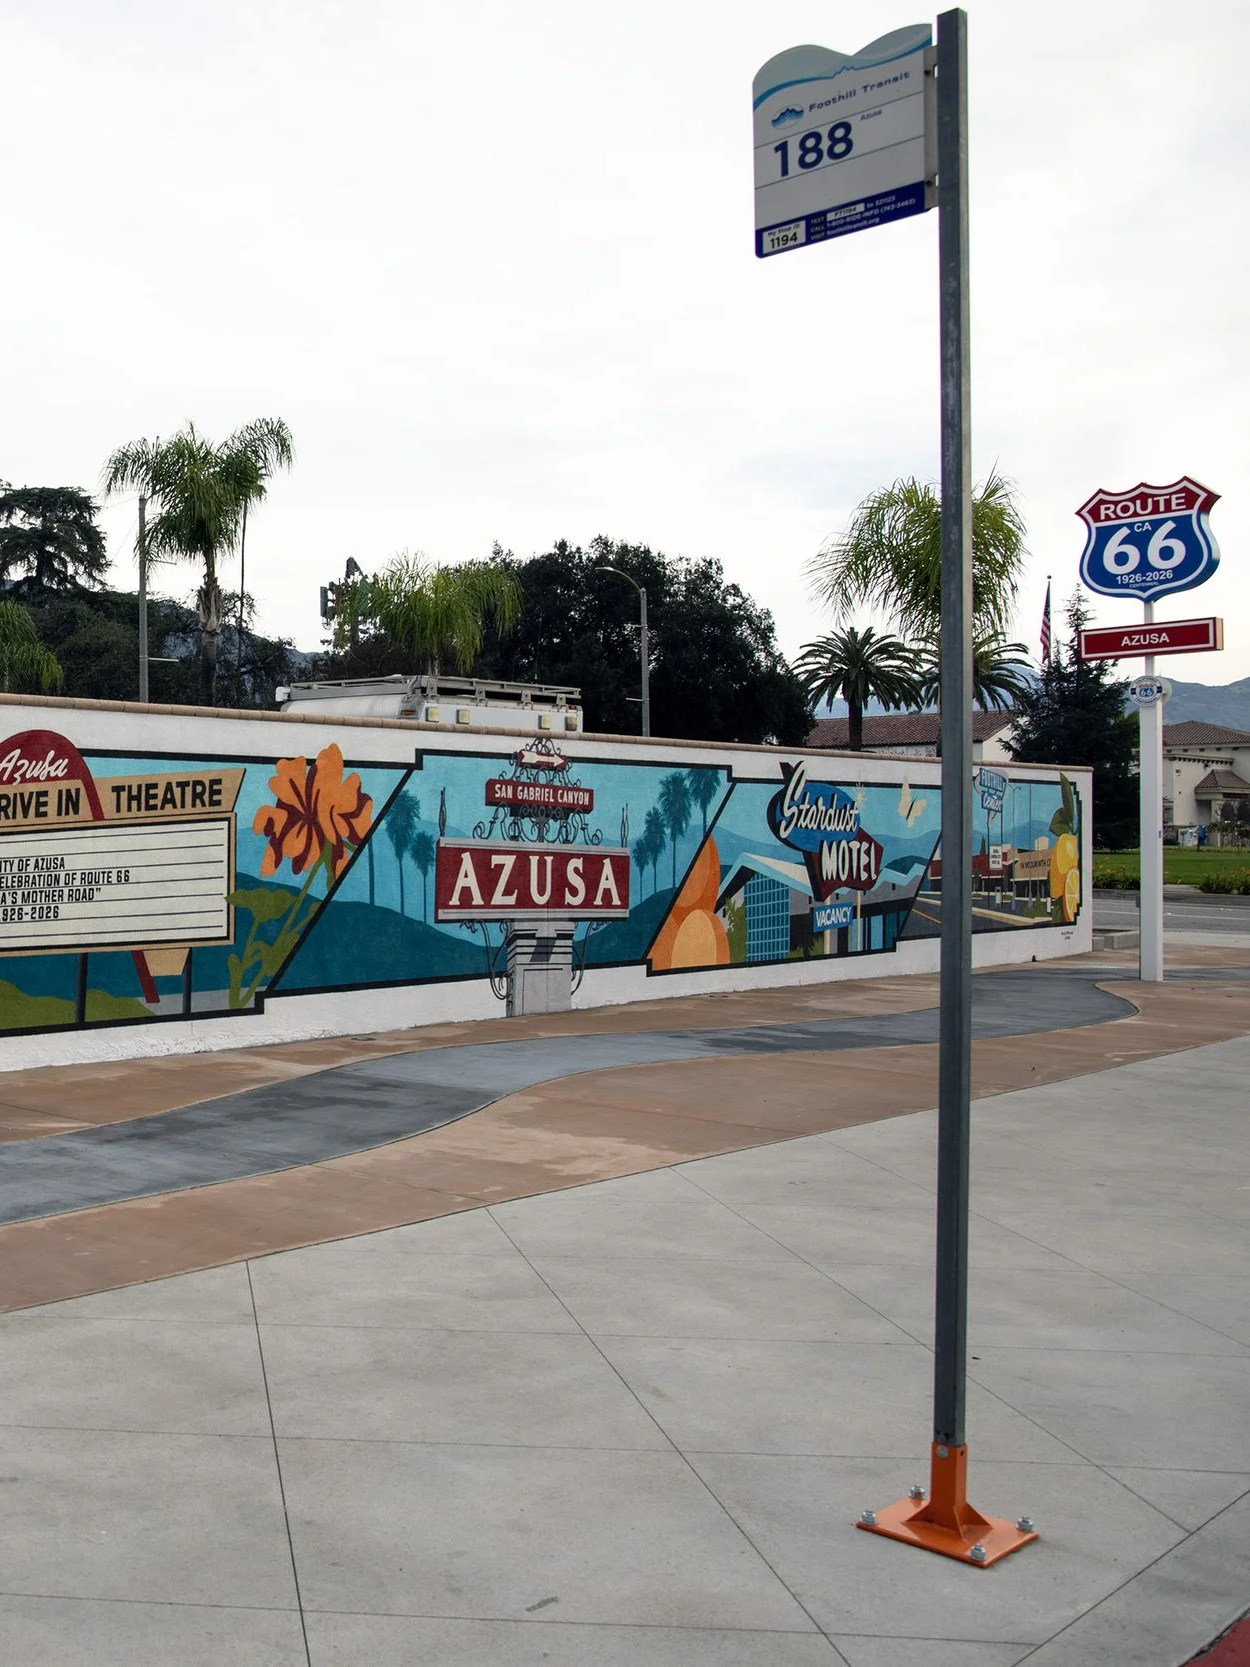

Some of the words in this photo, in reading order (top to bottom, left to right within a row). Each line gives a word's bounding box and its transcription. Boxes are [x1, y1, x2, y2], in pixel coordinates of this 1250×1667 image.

[809, 89, 856, 112] Foothill
[862, 71, 910, 93] Transit
[861, 109, 882, 121] Azusa
[773, 120, 854, 178] 188
[770, 231, 798, 249] 1194
[1100, 493, 1187, 520] ROUTE
[1134, 521, 1152, 533] CA
[1103, 520, 1186, 575] 66
[1116, 569, 1174, 585] 1926-2026
[1120, 632, 1170, 647] AZUSA
[1140, 688, 1153, 696] 66
[55, 787, 81, 816] IN
[111, 778, 223, 813] THEATRE
[494, 784, 513, 799] SAN
[517, 785, 555, 802] GABRIEL
[557, 789, 590, 805] CANYON
[780, 761, 859, 839] Stardust
[17, 858, 31, 872] OF
[33, 856, 66, 871] AZUSA
[821, 839, 877, 882] MOTEL
[64, 872, 77, 886] OF
[80, 870, 113, 885] ROUTE
[116, 869, 130, 883] 66
[448, 851, 622, 906] AZUSA
[21, 889, 64, 904] MOTHER
[815, 907, 851, 928] VACANCY
